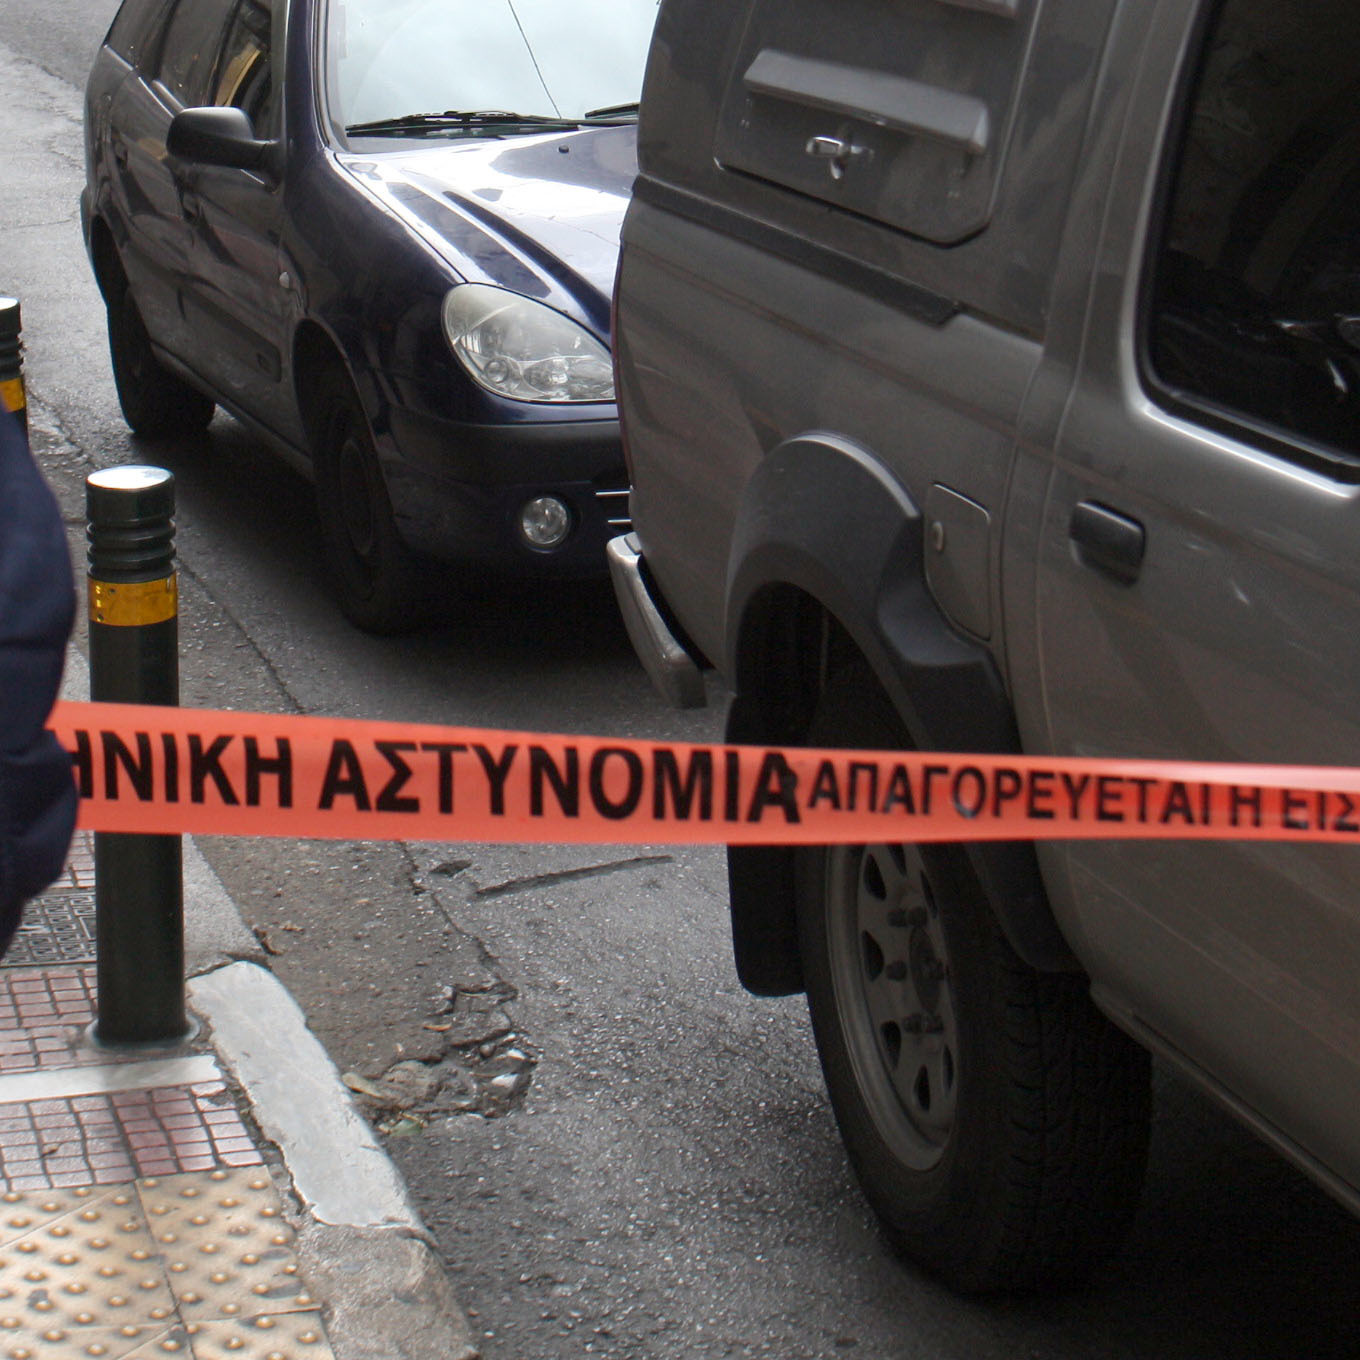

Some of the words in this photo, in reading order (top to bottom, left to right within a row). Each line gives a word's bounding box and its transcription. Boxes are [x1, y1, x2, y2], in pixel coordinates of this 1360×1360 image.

[70, 729, 293, 808] ΗΝΙΚΗ
[317, 738, 801, 824] ΑΣΤΥΝΟΜΙΑ
[807, 759, 1211, 827] ΑΠΑΓΟΡΕΥΕΤΑΙ
[1228, 784, 1262, 828] Η
